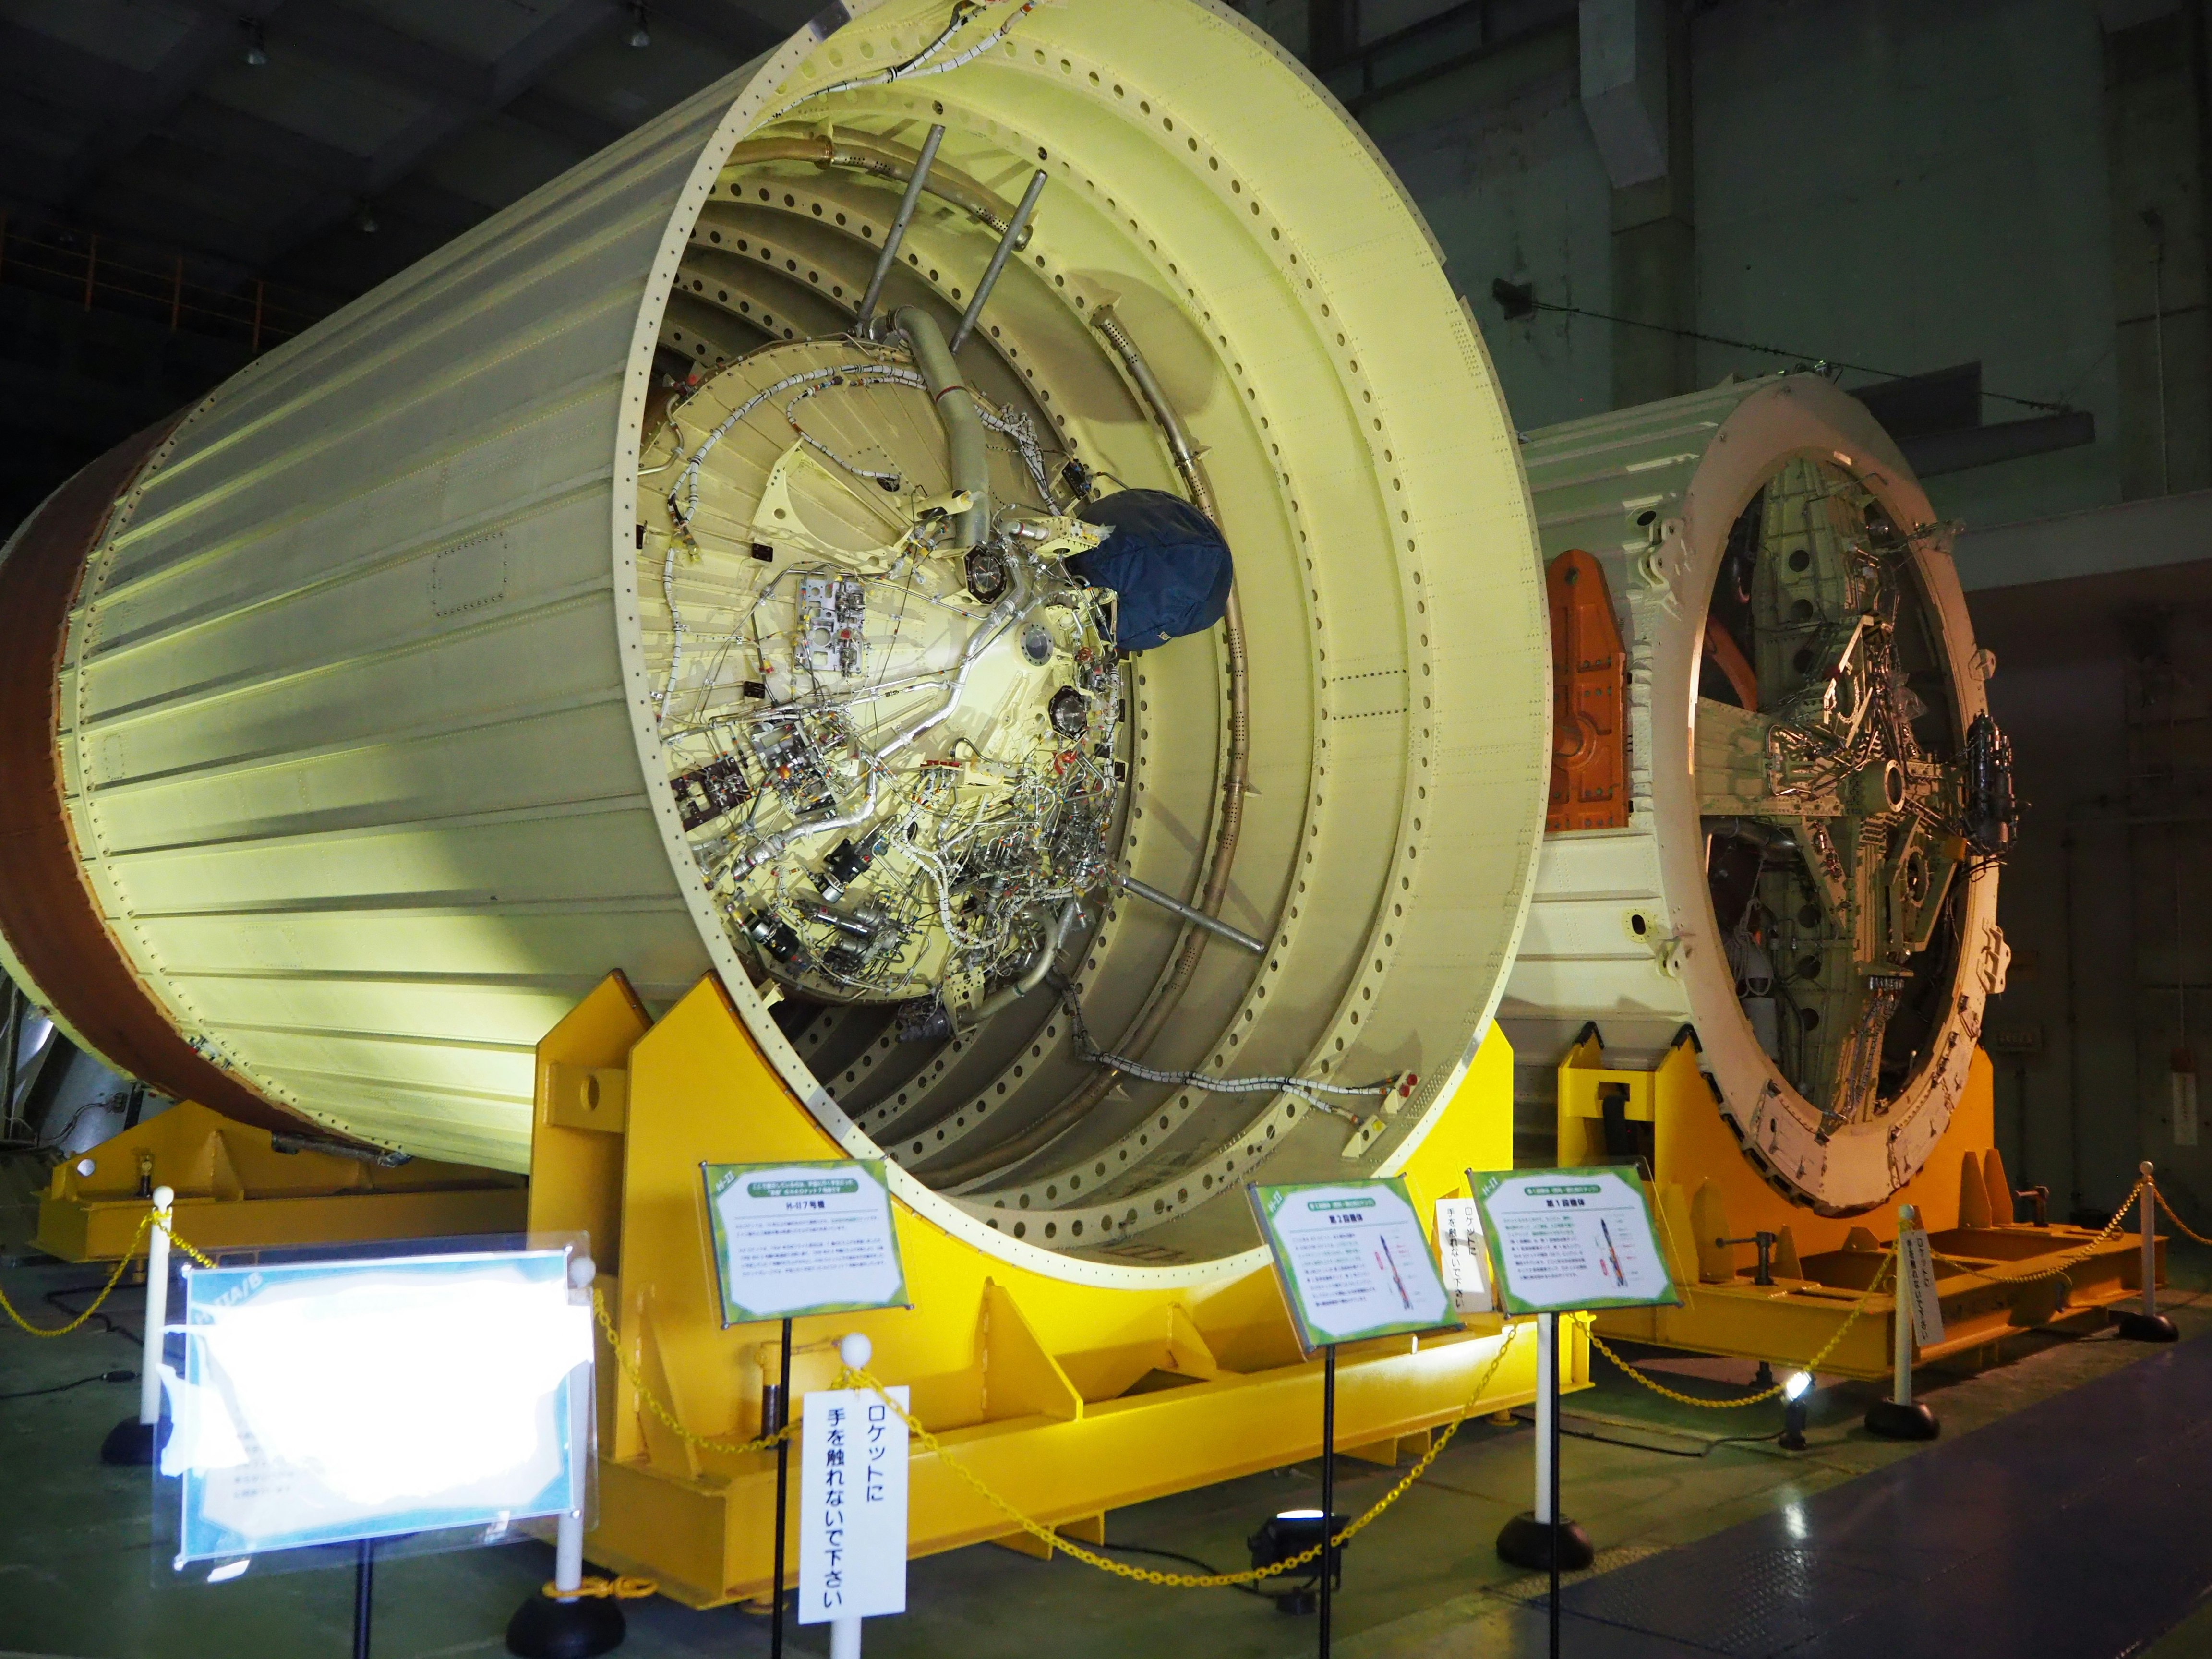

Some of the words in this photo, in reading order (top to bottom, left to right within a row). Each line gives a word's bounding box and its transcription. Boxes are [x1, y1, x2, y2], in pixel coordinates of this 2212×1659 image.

[1447, 1208, 1464, 1308] 手を触れないで下さい
[1465, 1207, 1477, 1256] ロケットに
[867, 1405, 886, 1503] ロケットに
[824, 1408, 846, 1608] 手を触れないで下さい
